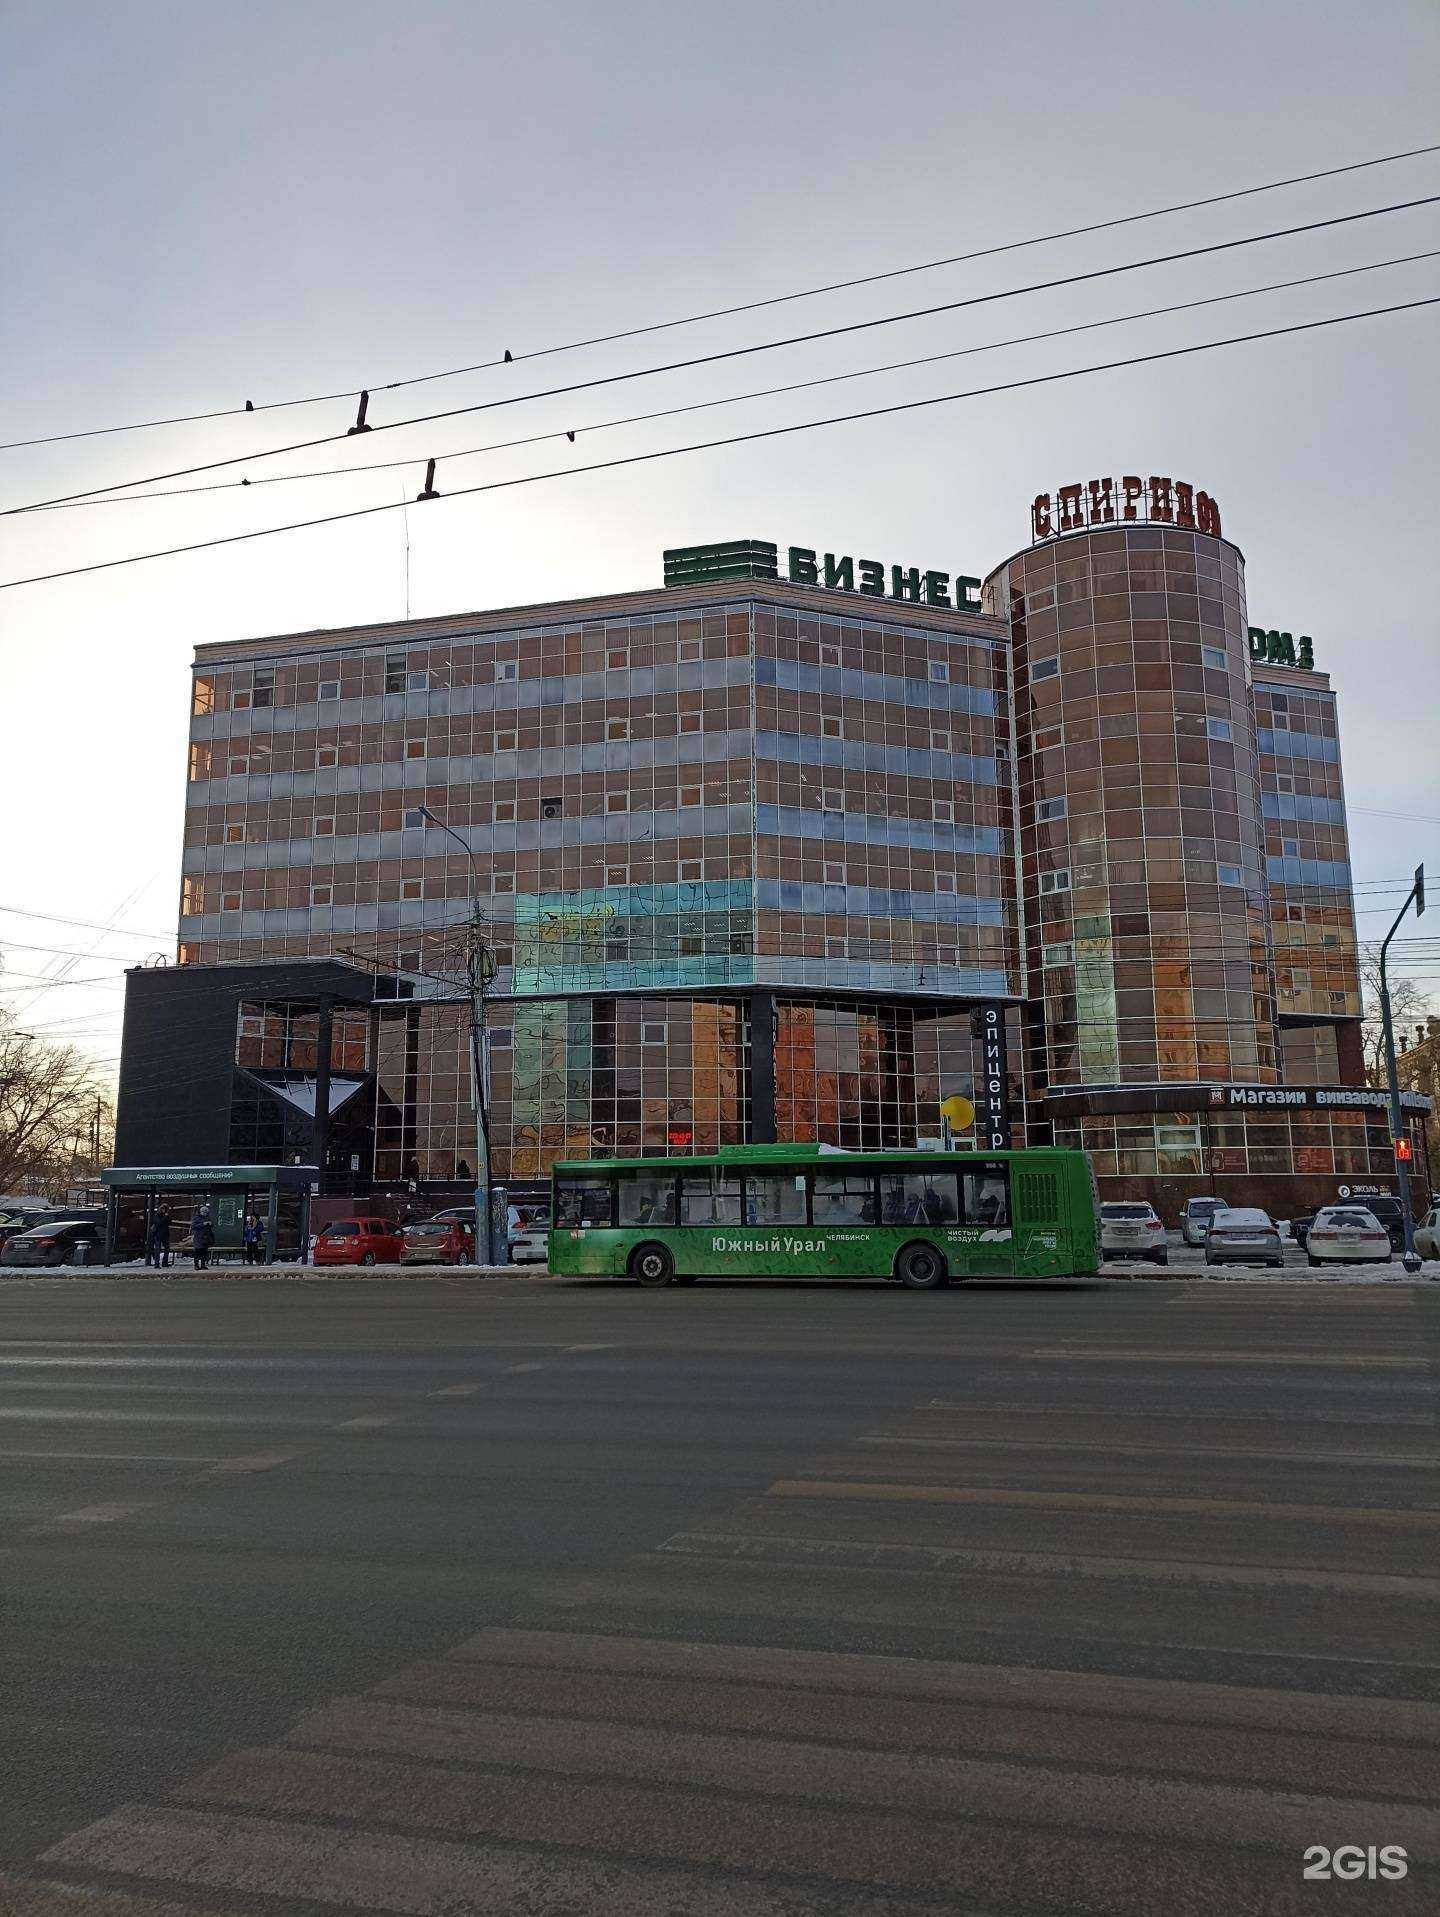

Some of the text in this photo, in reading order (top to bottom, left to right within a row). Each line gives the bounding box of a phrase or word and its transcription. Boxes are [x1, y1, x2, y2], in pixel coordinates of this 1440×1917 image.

[788, 546, 982, 613] БИЗНЕС
[1230, 1088, 1307, 1104] Магазин
[712, 1237, 826, 1256] Южный Урал
